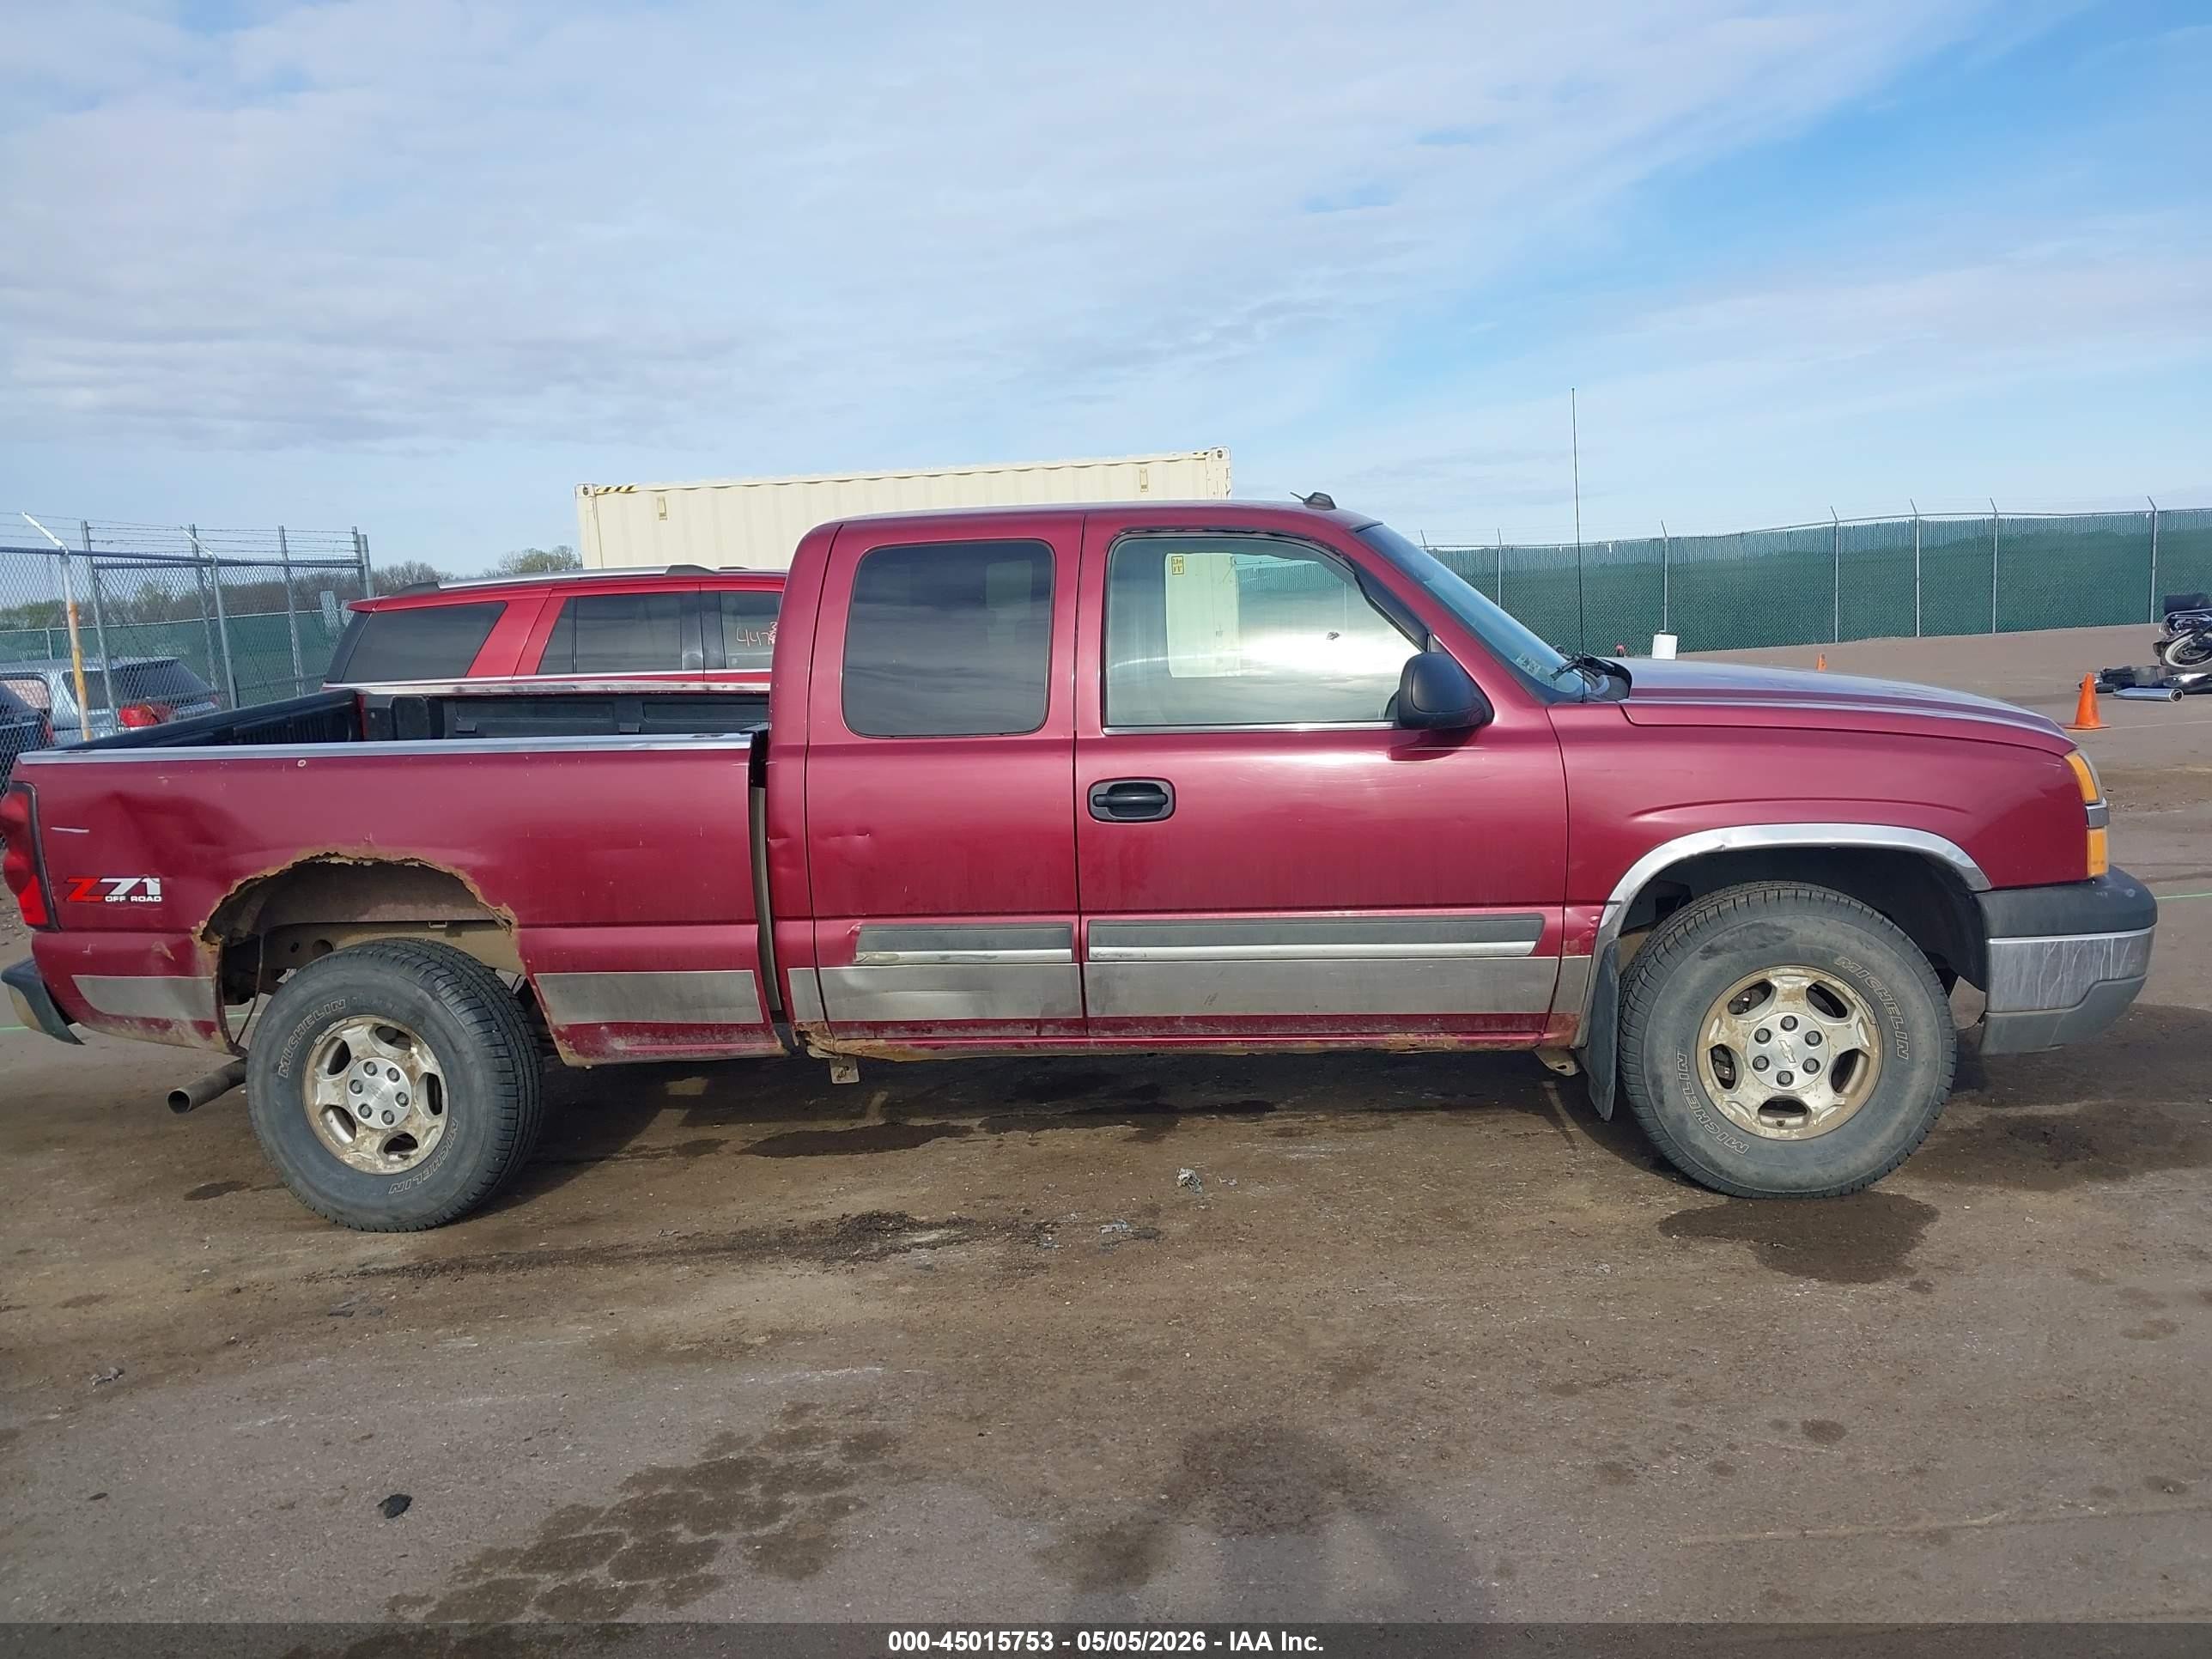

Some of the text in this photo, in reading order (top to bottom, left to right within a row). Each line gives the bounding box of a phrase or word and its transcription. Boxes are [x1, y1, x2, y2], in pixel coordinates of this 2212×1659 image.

[68, 876, 161, 902] Z71
[278, 999, 346, 1079] MICHELIN
[1835, 957, 1911, 1060] MICHELIN
[1676, 1048, 1750, 1155] MICHELIN
[388, 1119, 459, 1194] MICHELIN
